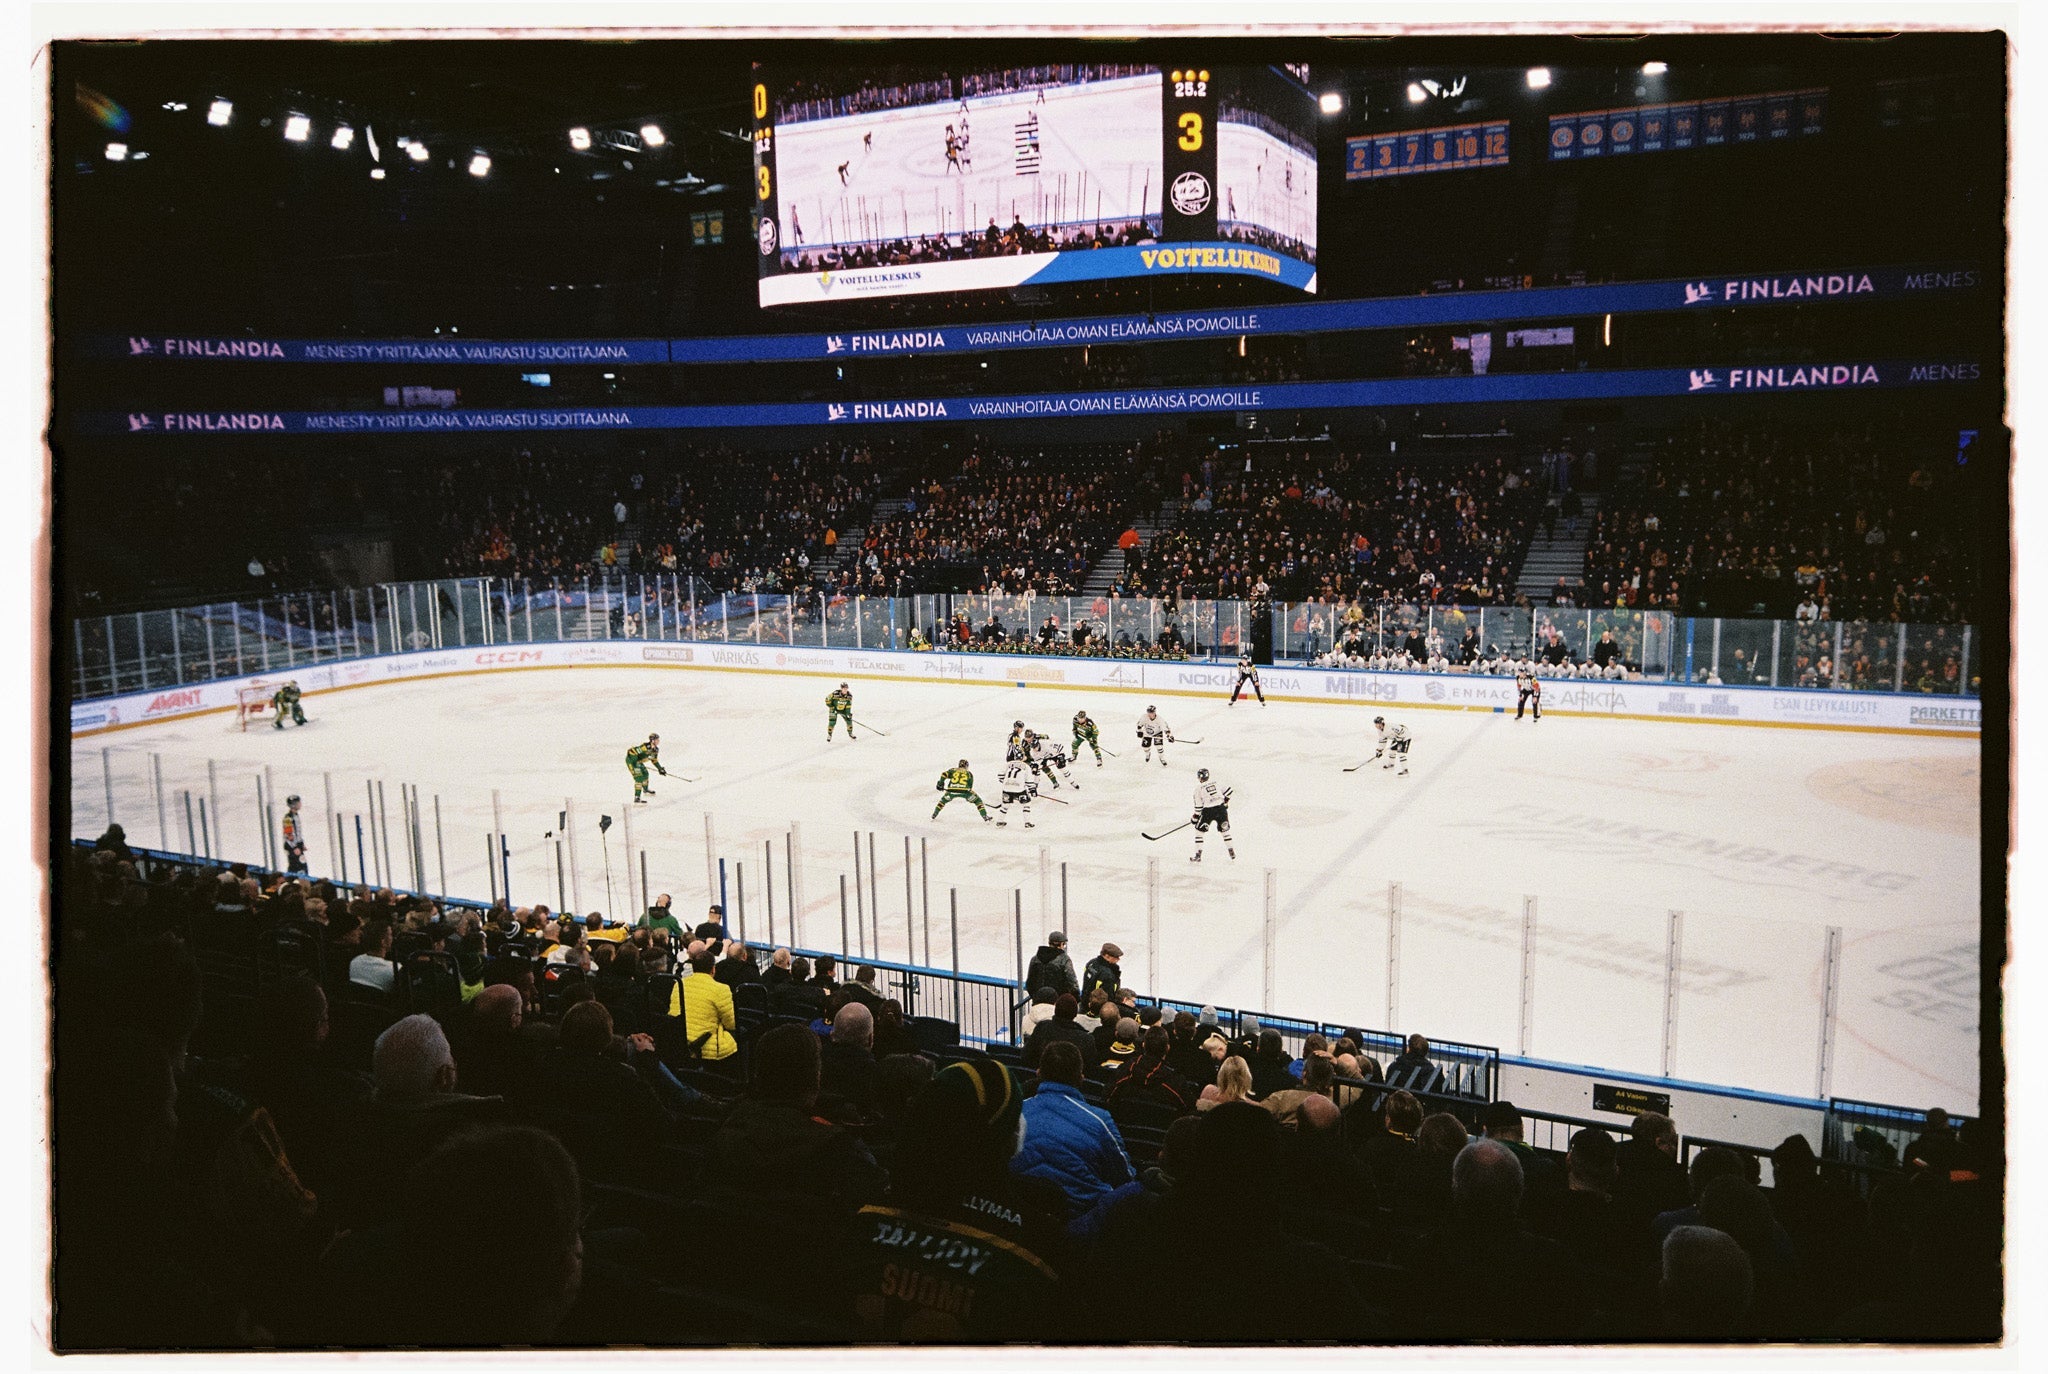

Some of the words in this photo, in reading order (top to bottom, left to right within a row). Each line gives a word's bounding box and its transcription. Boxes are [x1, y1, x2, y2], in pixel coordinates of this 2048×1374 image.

[1174, 81, 1206, 98] 25.2
[1177, 112, 1204, 152] 3
[1406, 142, 1418, 164] 7
[1433, 140, 1445, 160] 8
[1456, 136, 1477, 158] 10
[1484, 133, 1505, 155] 12
[1353, 149, 1365, 170] 2
[1379, 145, 1391, 166] 3
[758, 166, 770, 200] 3
[1141, 248, 1280, 276] VOITELUKESKUS
[839, 271, 921, 285] VOITELUKESKUS
[1725, 274, 1874, 300] FINLANDIA
[852, 332, 945, 351] FINLANDIA
[966, 328, 1064, 346] VARAINHOITAJA
[1067, 324, 1108, 339] OMAN
[1186, 314, 1261, 332] POMOILLE.
[165, 339, 285, 358] FINLANDIA
[304, 344, 373, 359] MENESTY
[463, 346, 535, 359] VAURASTU
[1729, 365, 1879, 388] FINLANDIA
[854, 402, 947, 420] FINLANDIA
[969, 399, 1067, 416] VARAINHOITAJA
[1070, 397, 1111, 411] OMAN
[1114, 393, 1187, 411] ELÄMÄNSÄ
[1189, 392, 1264, 408] POMOILLE.
[165, 414, 285, 430] FINLANDIA
[306, 414, 375, 429] MENESTY
[464, 412, 537, 427] VAURASTU
[422, 658, 457, 670] Media
[475, 650, 544, 665] CCM
[712, 650, 759, 665] VÄRIKÄS
[848, 661, 905, 671] TELAKONE
[1178, 672, 1239, 688] NOKIA
[1325, 676, 1397, 700] Millog
[147, 689, 203, 713] AVANT
[1773, 698, 1800, 709] ESAN
[1626, 1092, 1648, 1102] Vasen
